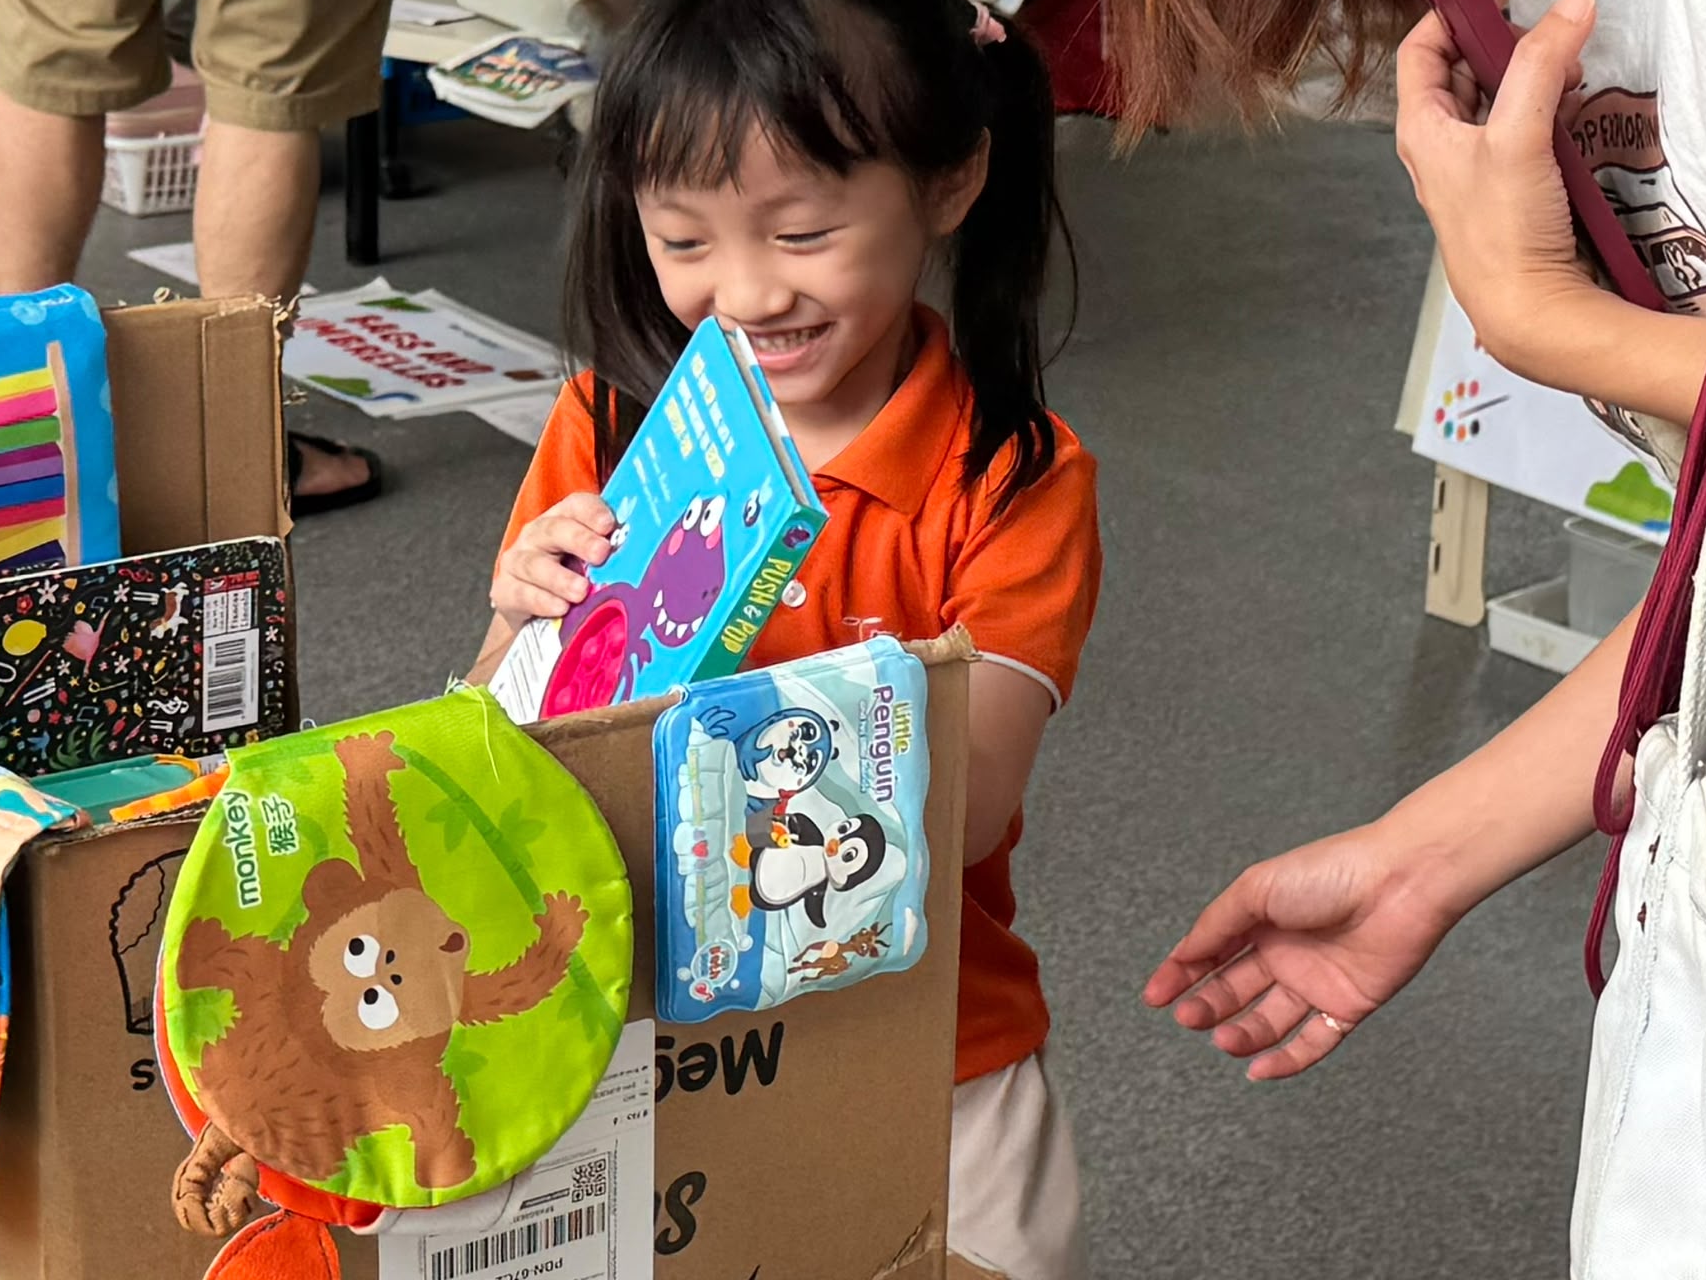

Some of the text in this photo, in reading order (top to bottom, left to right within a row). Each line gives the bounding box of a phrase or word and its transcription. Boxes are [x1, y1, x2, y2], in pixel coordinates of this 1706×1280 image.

[1600, 112, 1660, 151] EXPLORIN
[720, 555, 793, 656] PUSH & POP
[872, 684, 896, 804] Penguin
[894, 700, 911, 757] Little
[222, 790, 260, 907] monkey
[262, 795, 296, 855] 猴子
